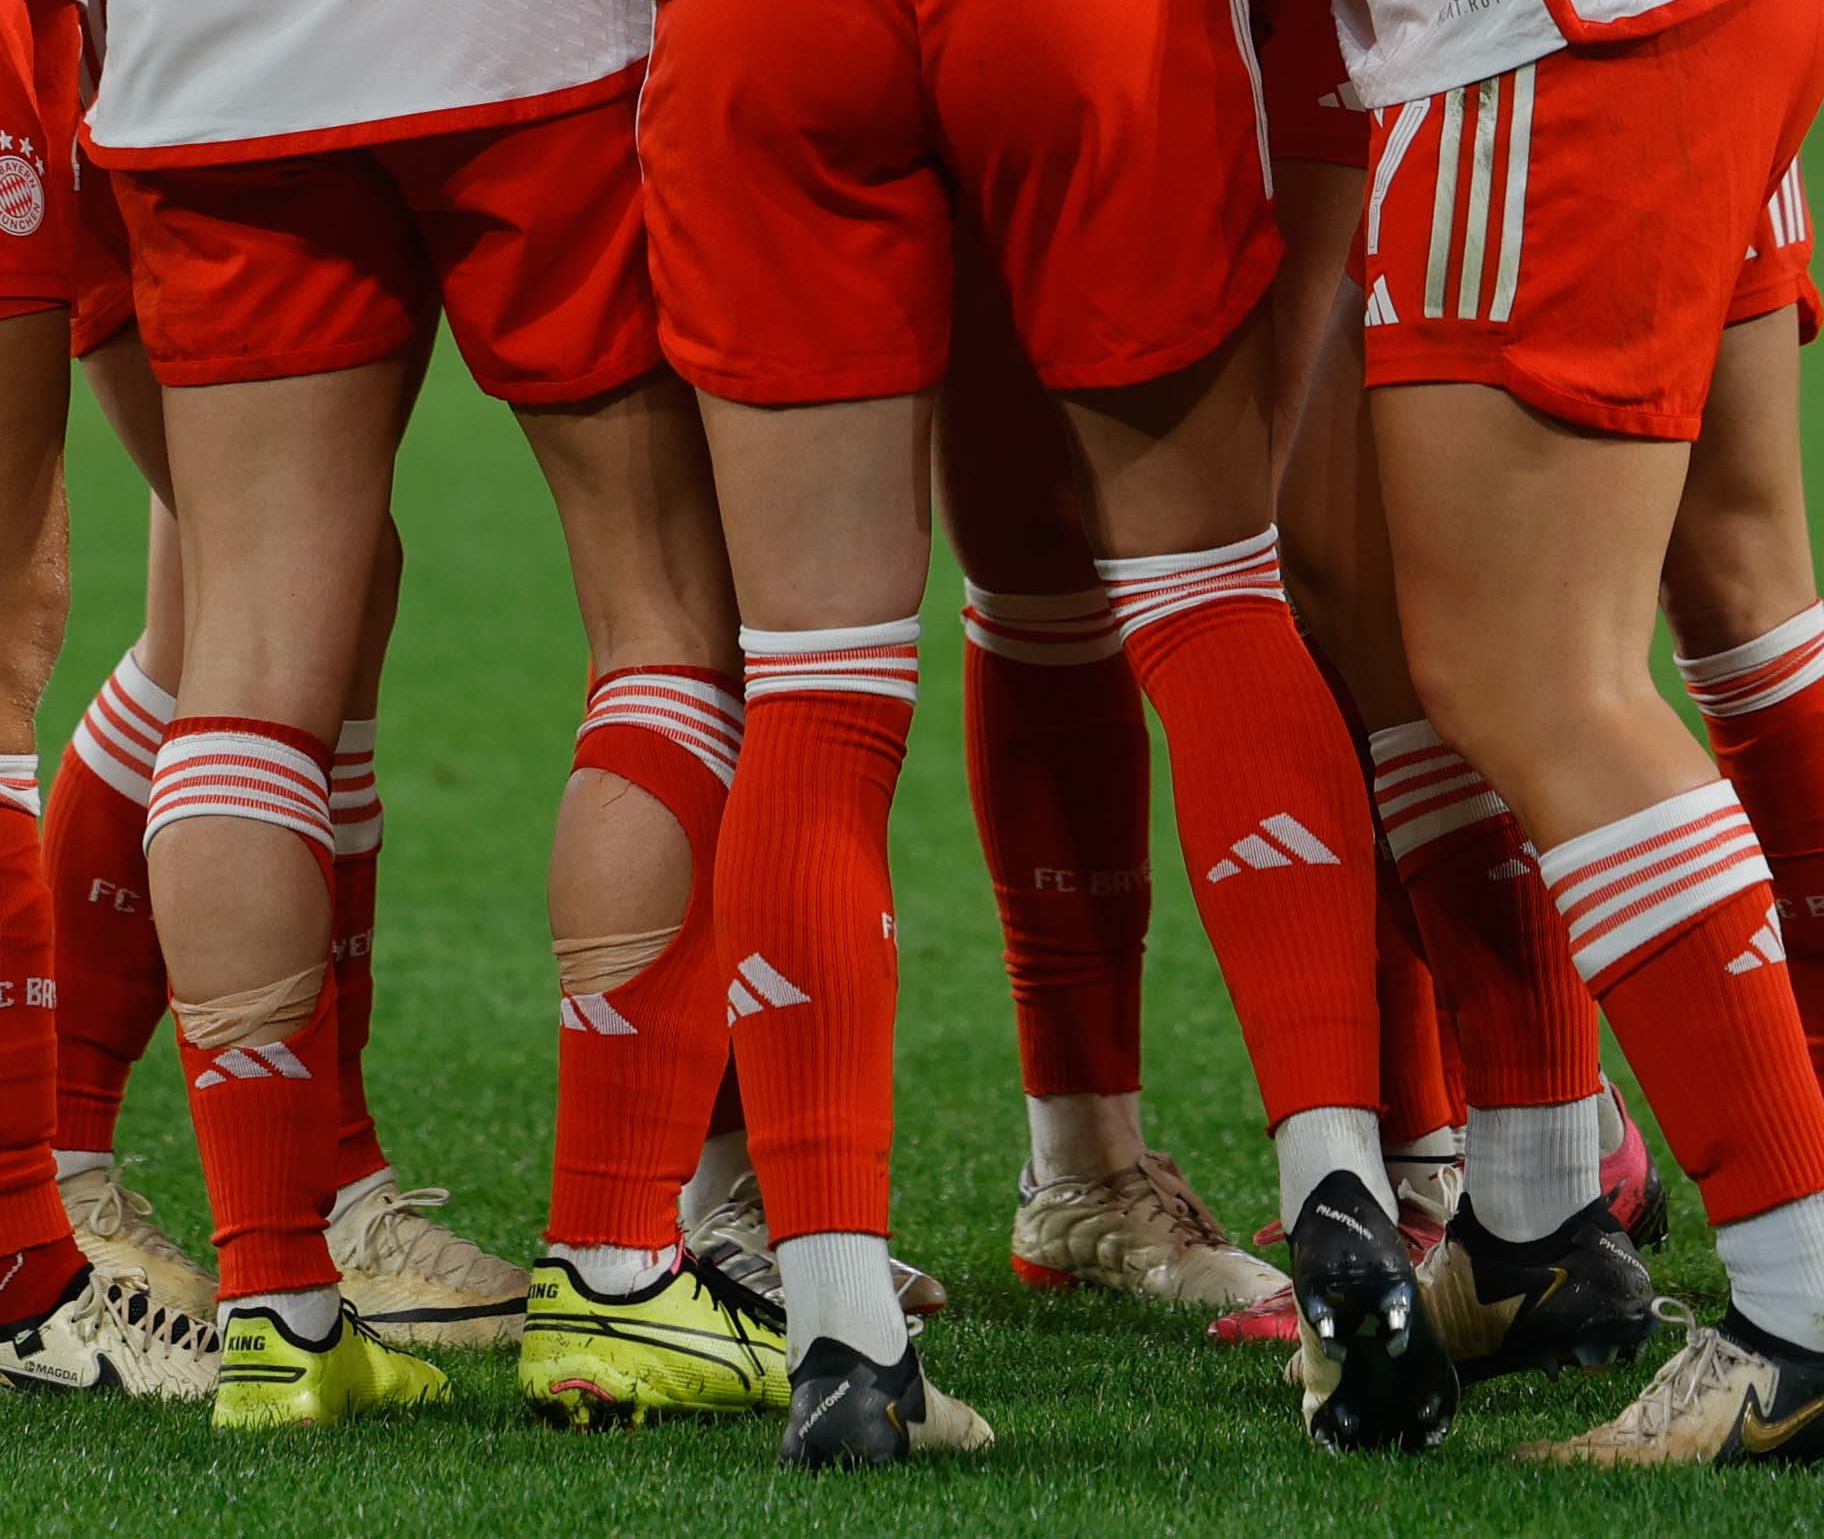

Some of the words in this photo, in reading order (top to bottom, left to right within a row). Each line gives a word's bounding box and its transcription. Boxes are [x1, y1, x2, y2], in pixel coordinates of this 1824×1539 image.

[1034, 868, 1076, 893] FC
[88, 877, 142, 913] FC
[227, 1335, 266, 1351] KING
[36, 1363, 78, 1383] MAGDA
